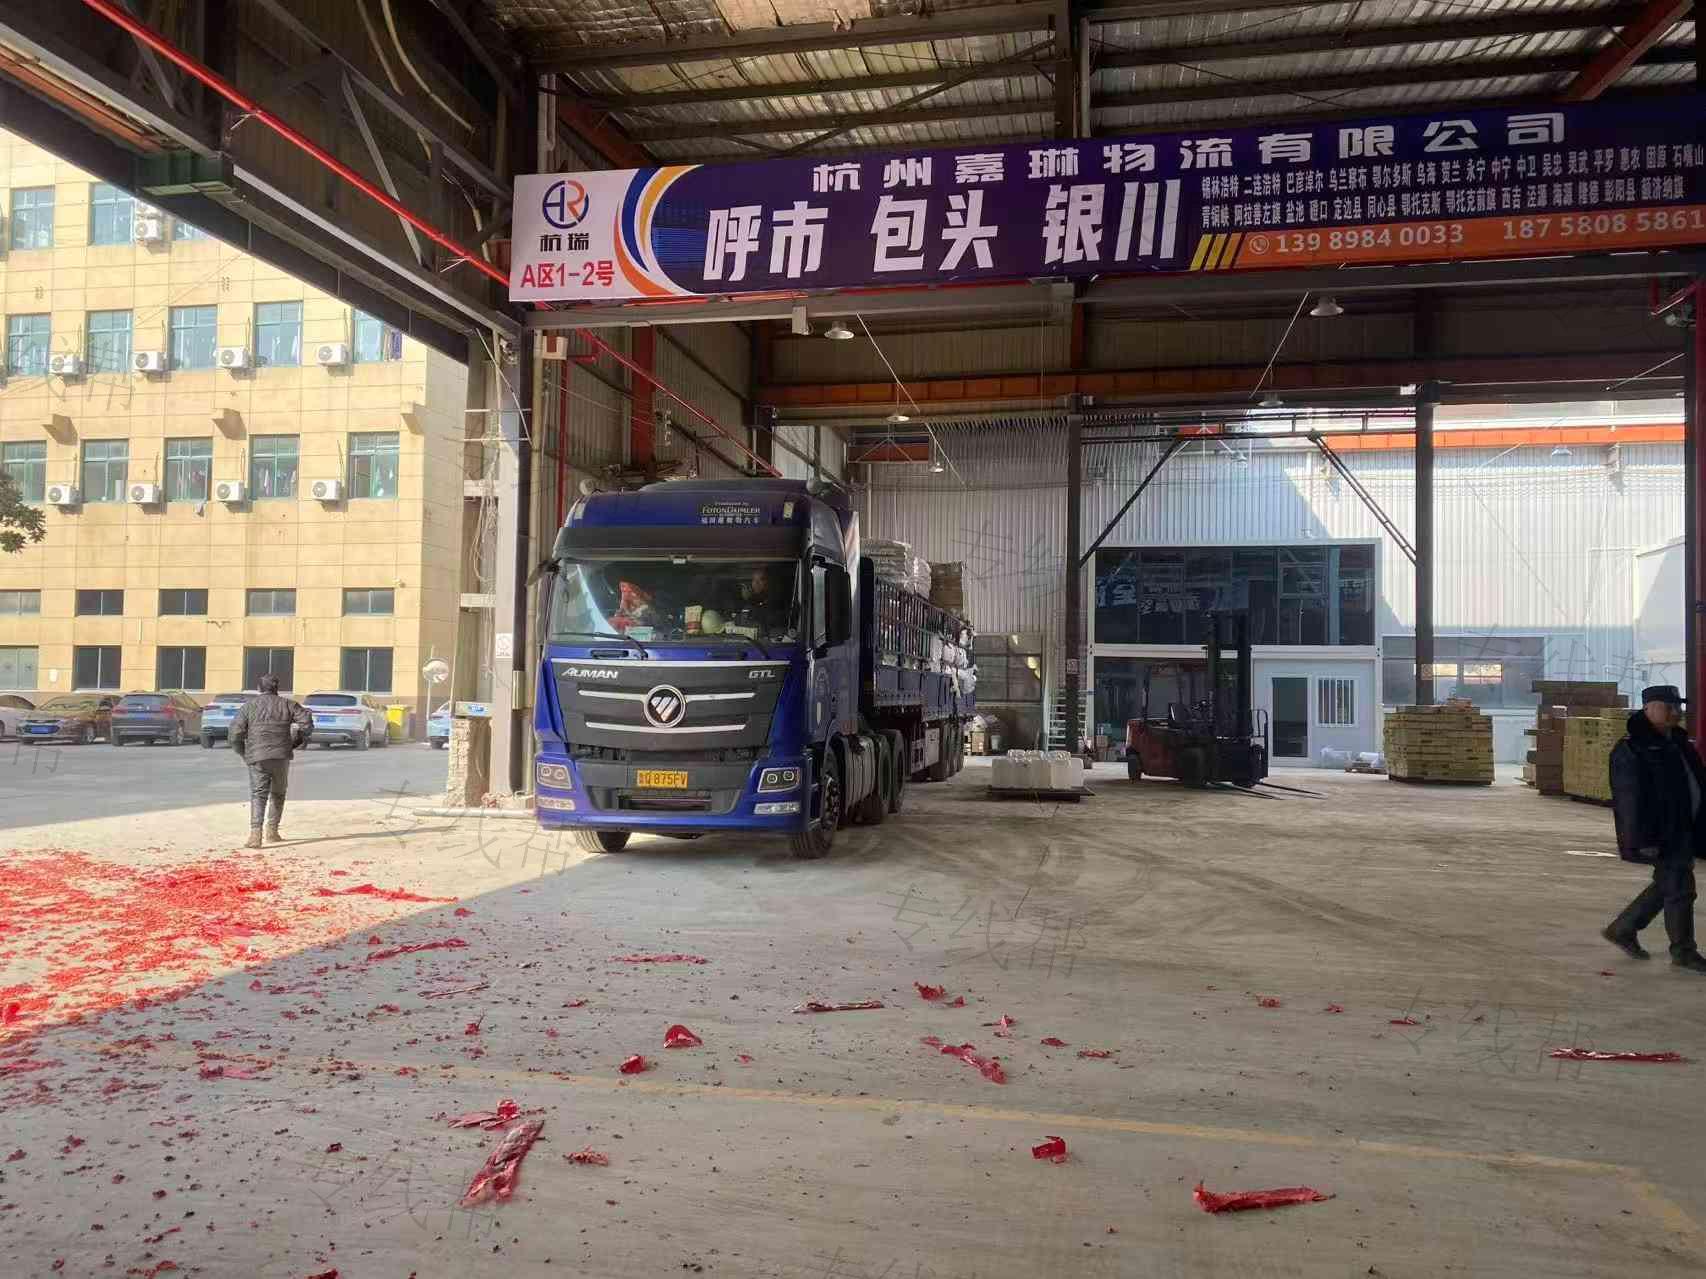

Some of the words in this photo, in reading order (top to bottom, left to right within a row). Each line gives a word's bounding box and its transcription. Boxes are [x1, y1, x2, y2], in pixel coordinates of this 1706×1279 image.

[813, 112, 1565, 192] 杭州嘉琳物流有限公司
[1492, 156, 1511, 180] 中宁
[1517, 154, 1537, 179] 中卫
[1542, 152, 1562, 176] 吴忠
[538, 232, 590, 252] 杭瑞
[703, 200, 829, 282] 呼市
[870, 190, 998, 272] 包头
[1042, 179, 1181, 265] 银川
[1277, 232, 1321, 253] 139
[1329, 228, 1392, 250] 8984
[1400, 223, 1465, 246] 0033
[1503, 218, 1551, 240] 187
[1560, 213, 1628, 236] 5808
[1636, 209, 1706, 232] 5861
[520, 260, 615, 288] A区1-2号
[561, 667, 619, 680] AUMAN
[749, 669, 776, 680] GTL
